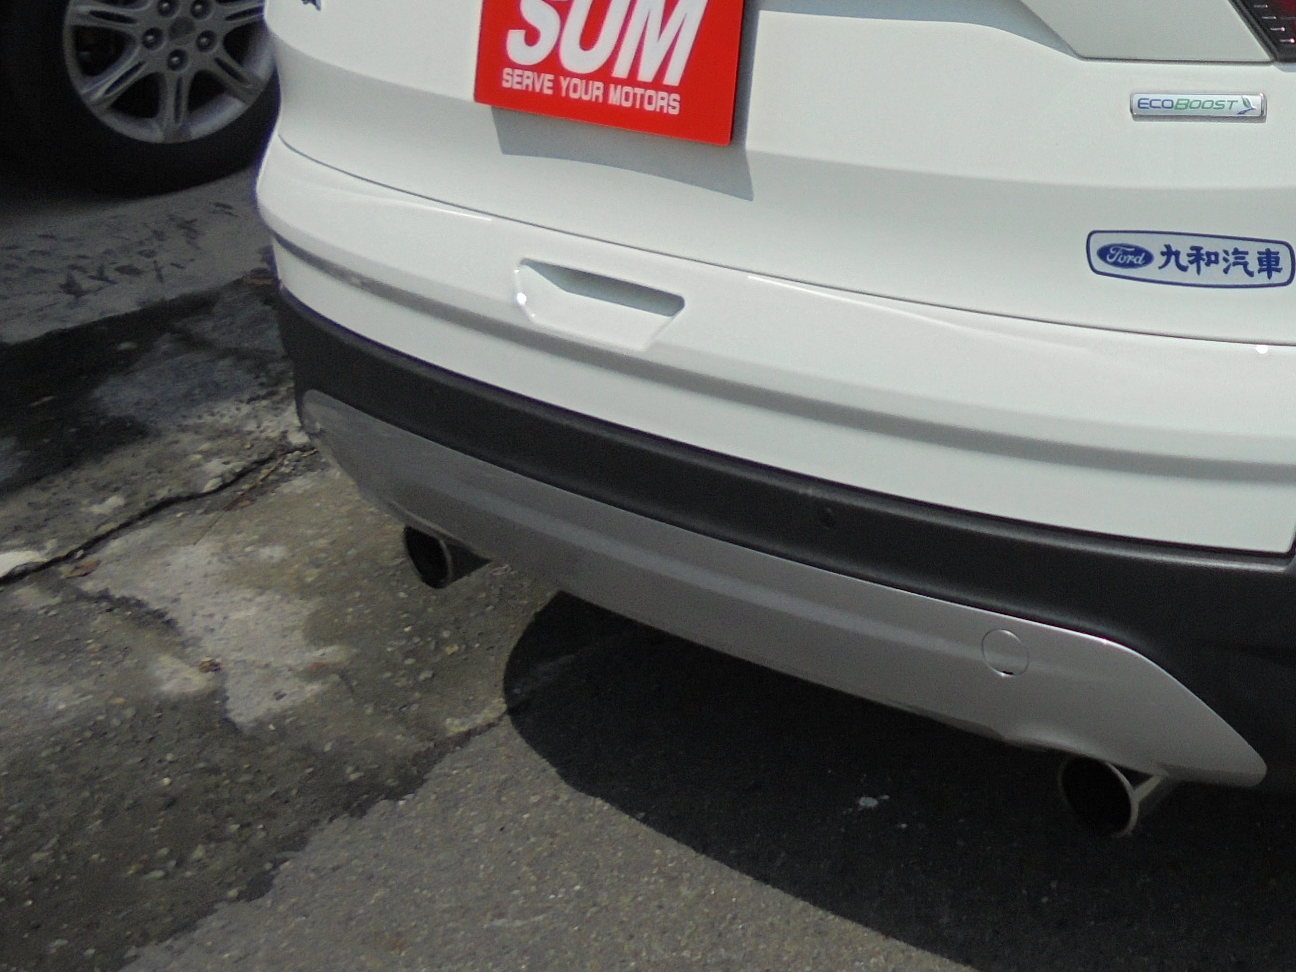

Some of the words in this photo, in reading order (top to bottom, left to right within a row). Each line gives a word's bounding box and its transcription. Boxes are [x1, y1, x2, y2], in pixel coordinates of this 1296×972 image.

[501, 67, 554, 95] SERVE
[560, 75, 604, 102] YOUR
[608, 83, 682, 116] MOTORS
[1106, 245, 1146, 266] Ford
[1157, 243, 1284, 280] 九和汽車
